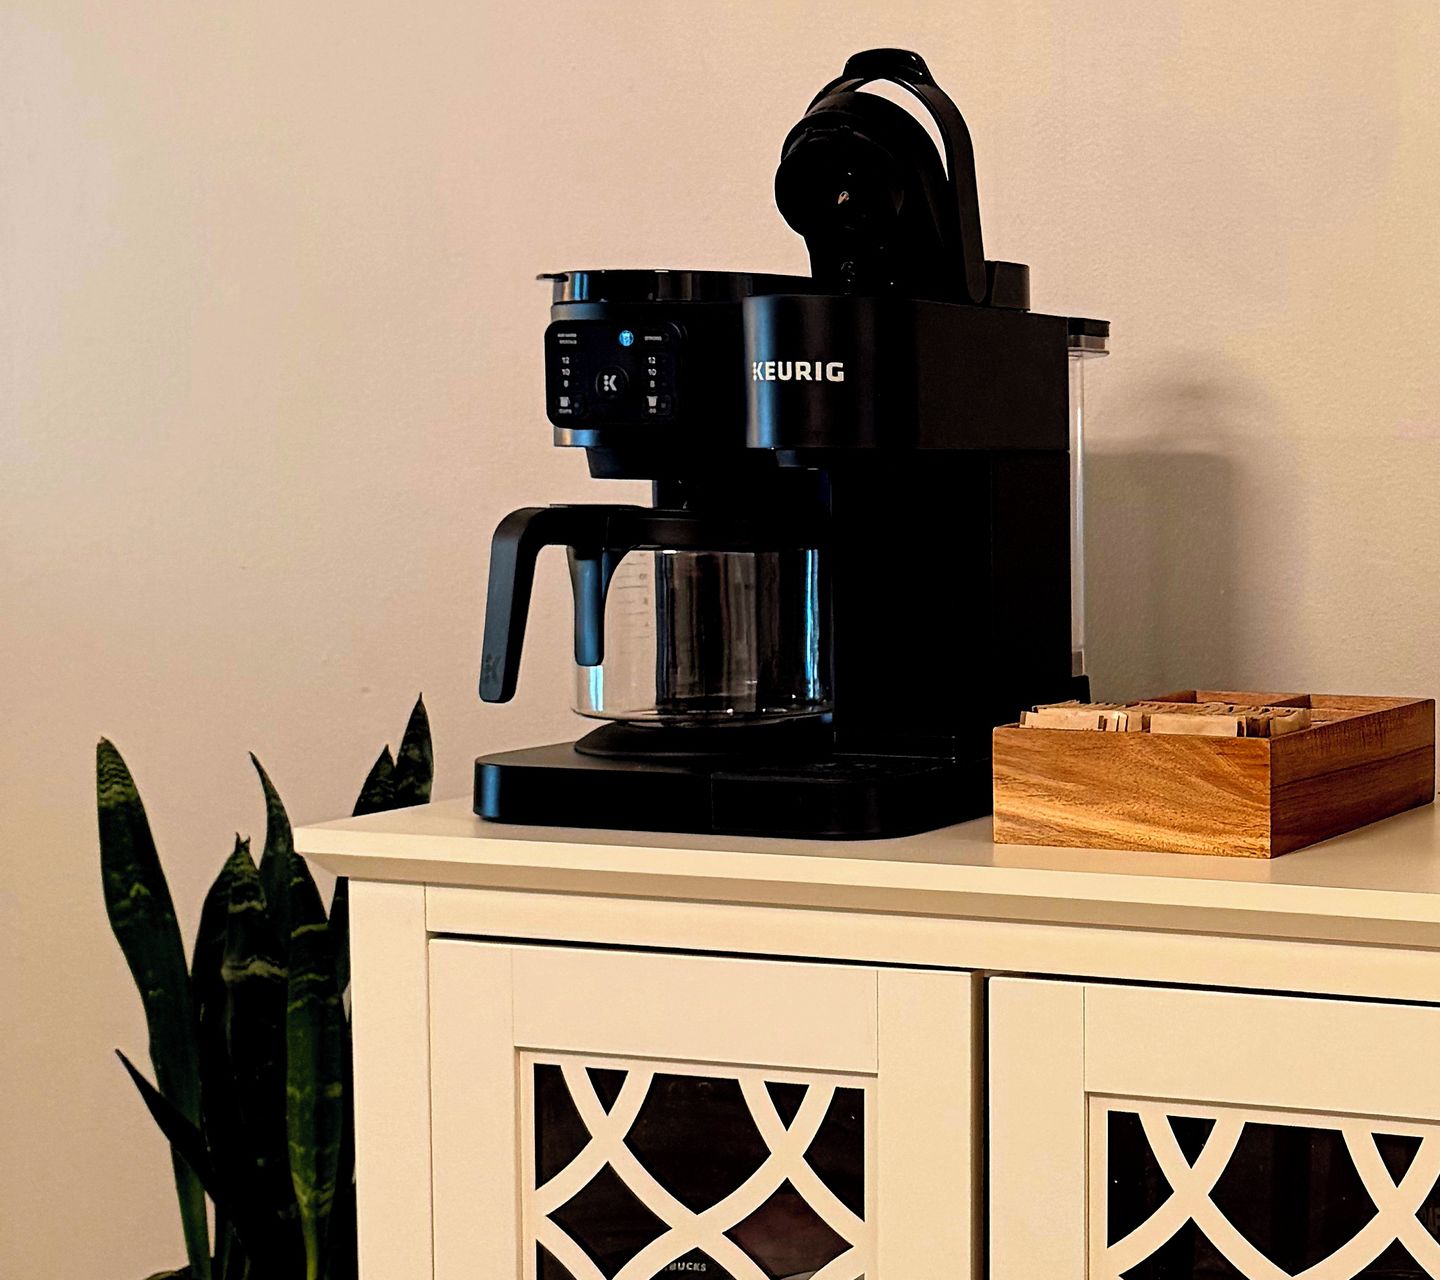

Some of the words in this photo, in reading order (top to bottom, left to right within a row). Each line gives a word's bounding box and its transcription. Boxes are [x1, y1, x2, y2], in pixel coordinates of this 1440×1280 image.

[561, 356, 570, 364] 12
[648, 356, 656, 364] 12
[752, 361, 845, 382] KEURIG
[664, 1261, 707, 1272] BUCKS
